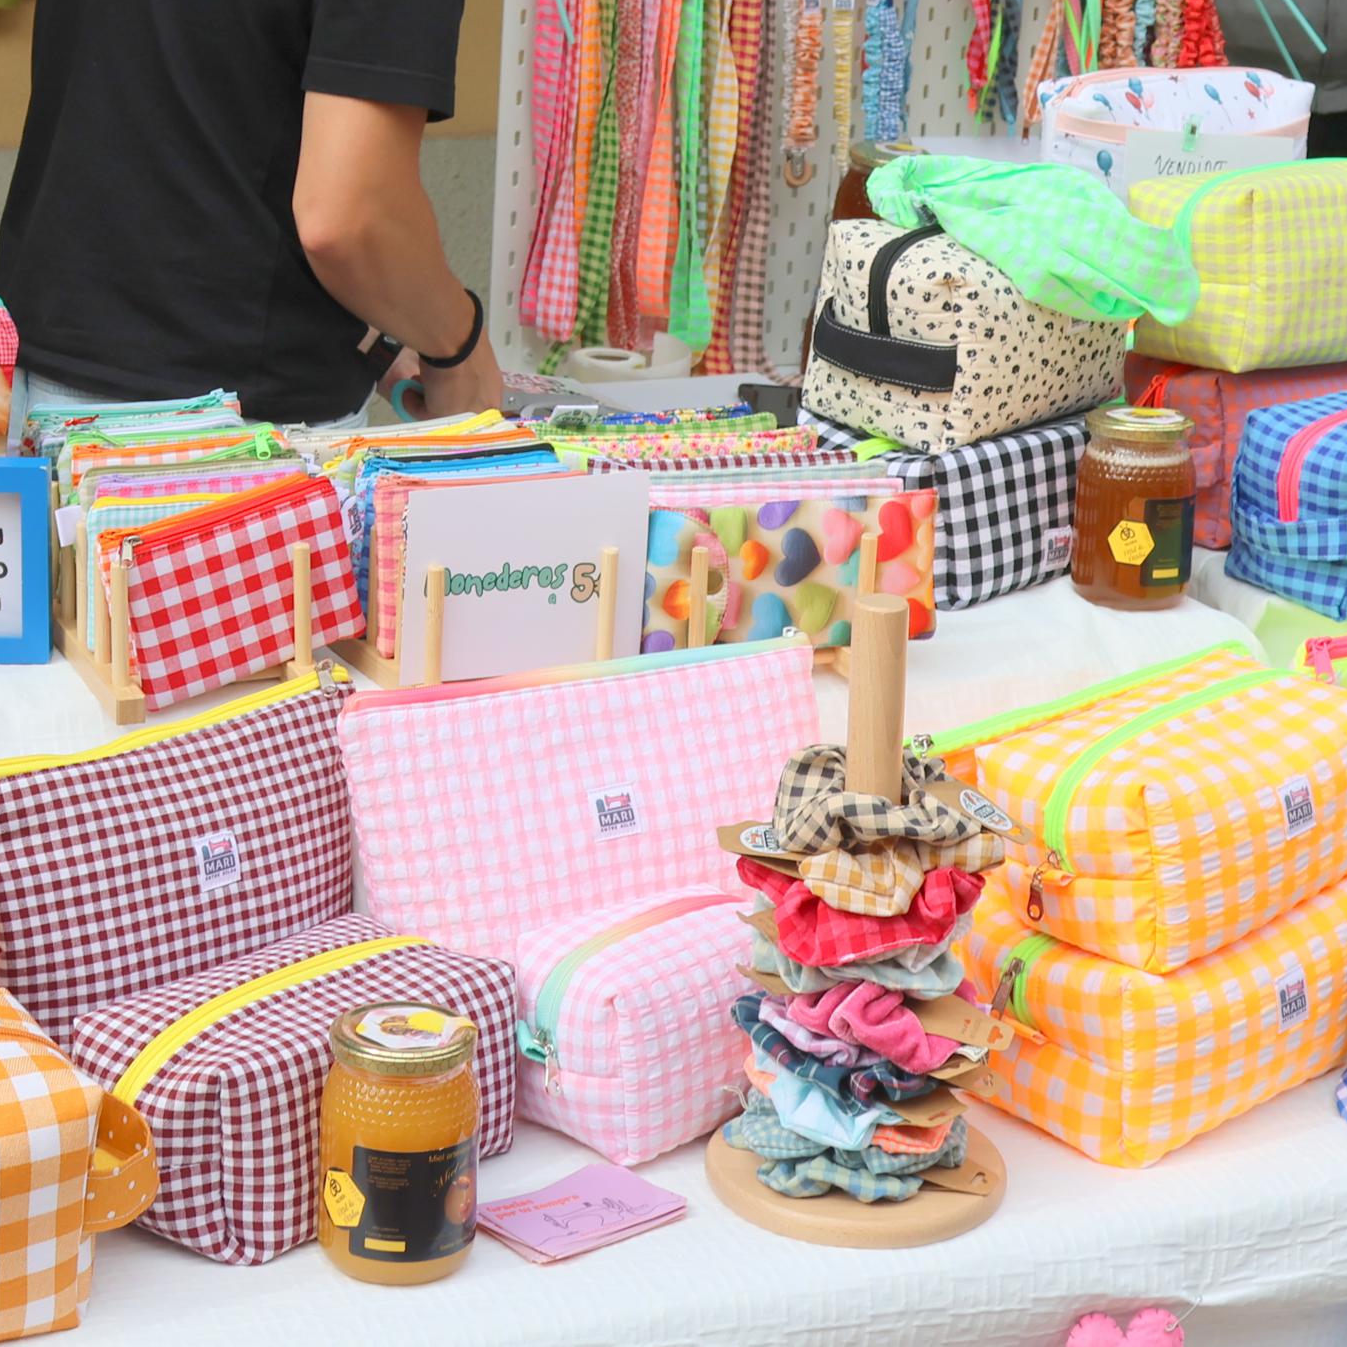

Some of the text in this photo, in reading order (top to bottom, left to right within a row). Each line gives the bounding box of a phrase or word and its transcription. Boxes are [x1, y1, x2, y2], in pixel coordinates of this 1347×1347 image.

[599, 809, 634, 826] MARI
[1288, 802, 1313, 825] MARI
[205, 855, 234, 873] MARI
[1282, 994, 1307, 1018] MARI
